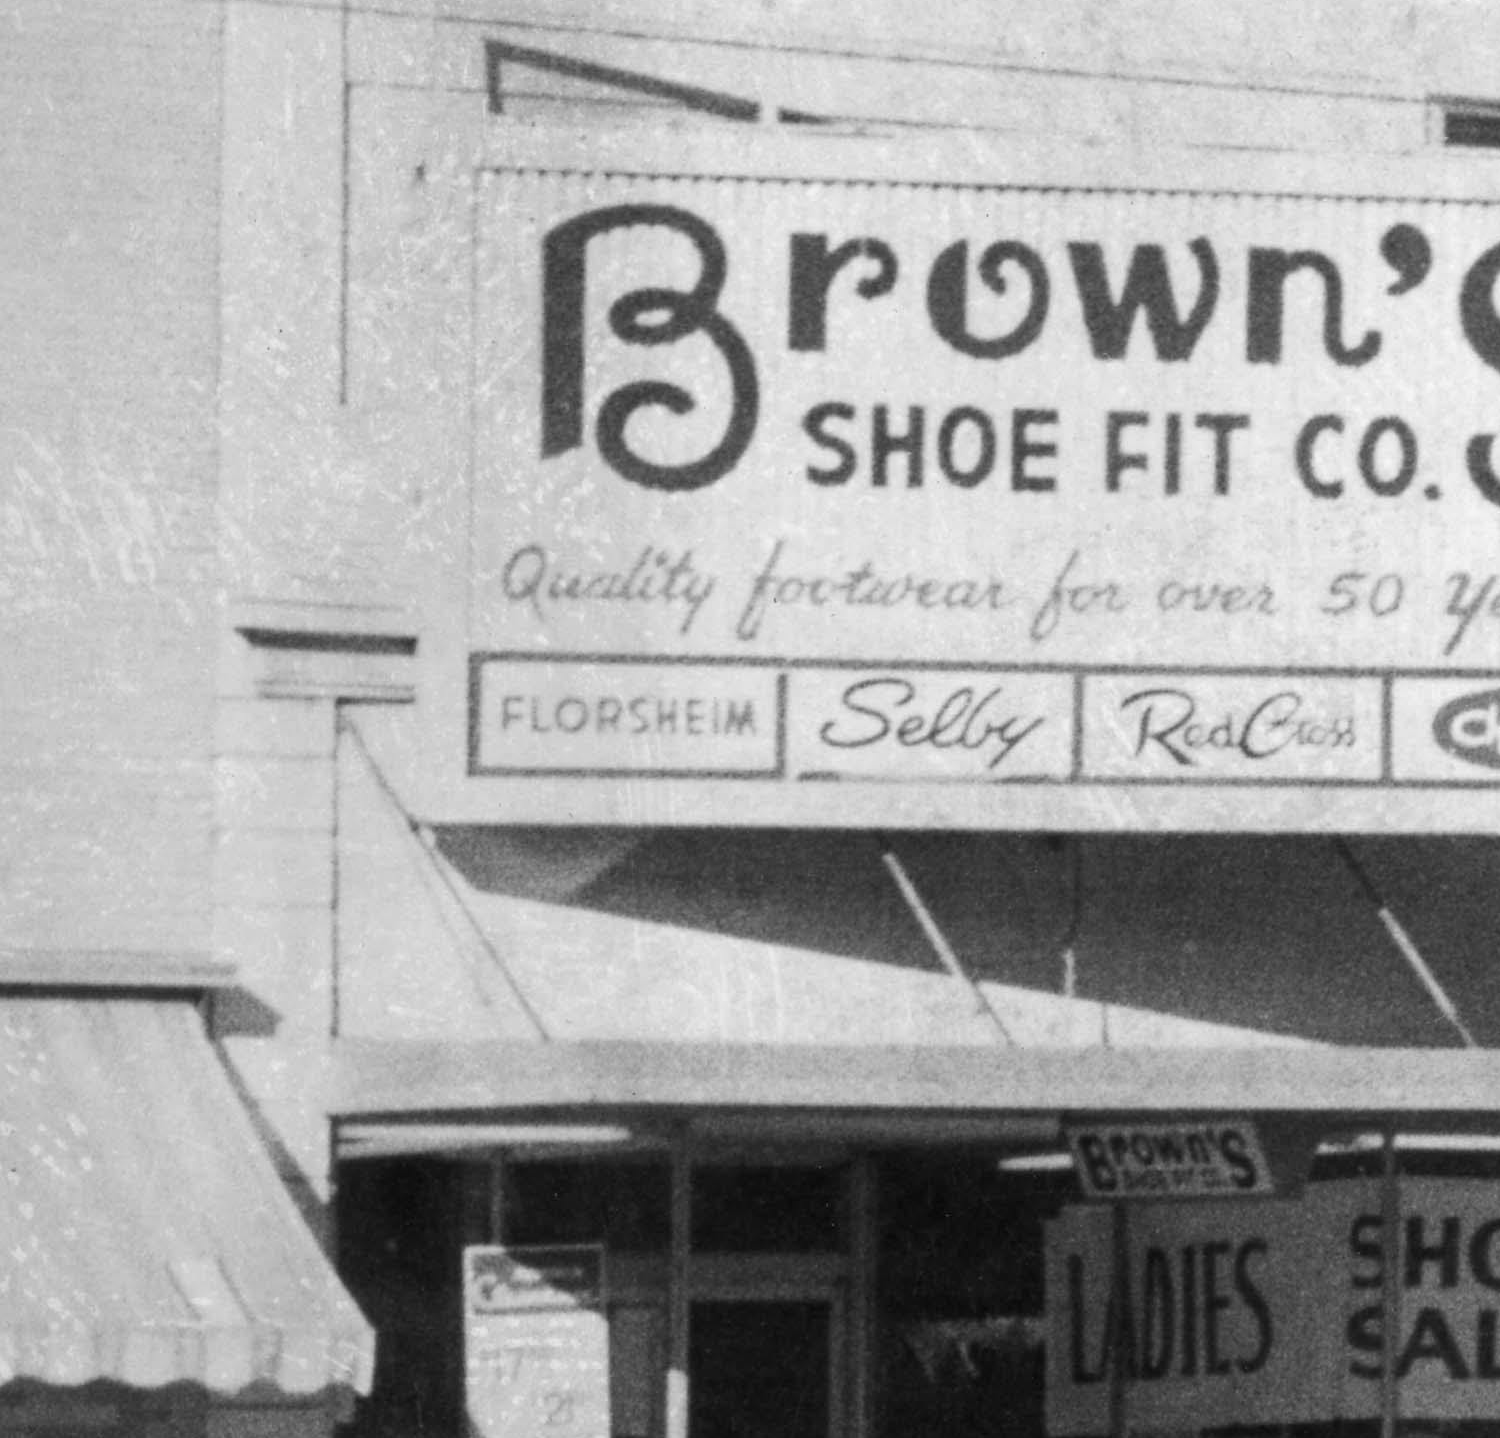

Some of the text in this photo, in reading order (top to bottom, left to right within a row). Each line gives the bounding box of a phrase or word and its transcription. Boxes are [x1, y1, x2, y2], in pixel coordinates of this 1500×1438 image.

[804, 402, 1442, 501] SHOE FIT CO.
[503, 544, 716, 636] Quality
[736, 539, 1016, 641] footwear
[1029, 549, 1128, 641] for
[1157, 576, 1279, 616] over
[1321, 572, 1404, 618] 50
[502, 696, 758, 736] FLORSHEIM
[819, 677, 1045, 769] Selby
[1069, 1239, 1275, 1386] LADIES
